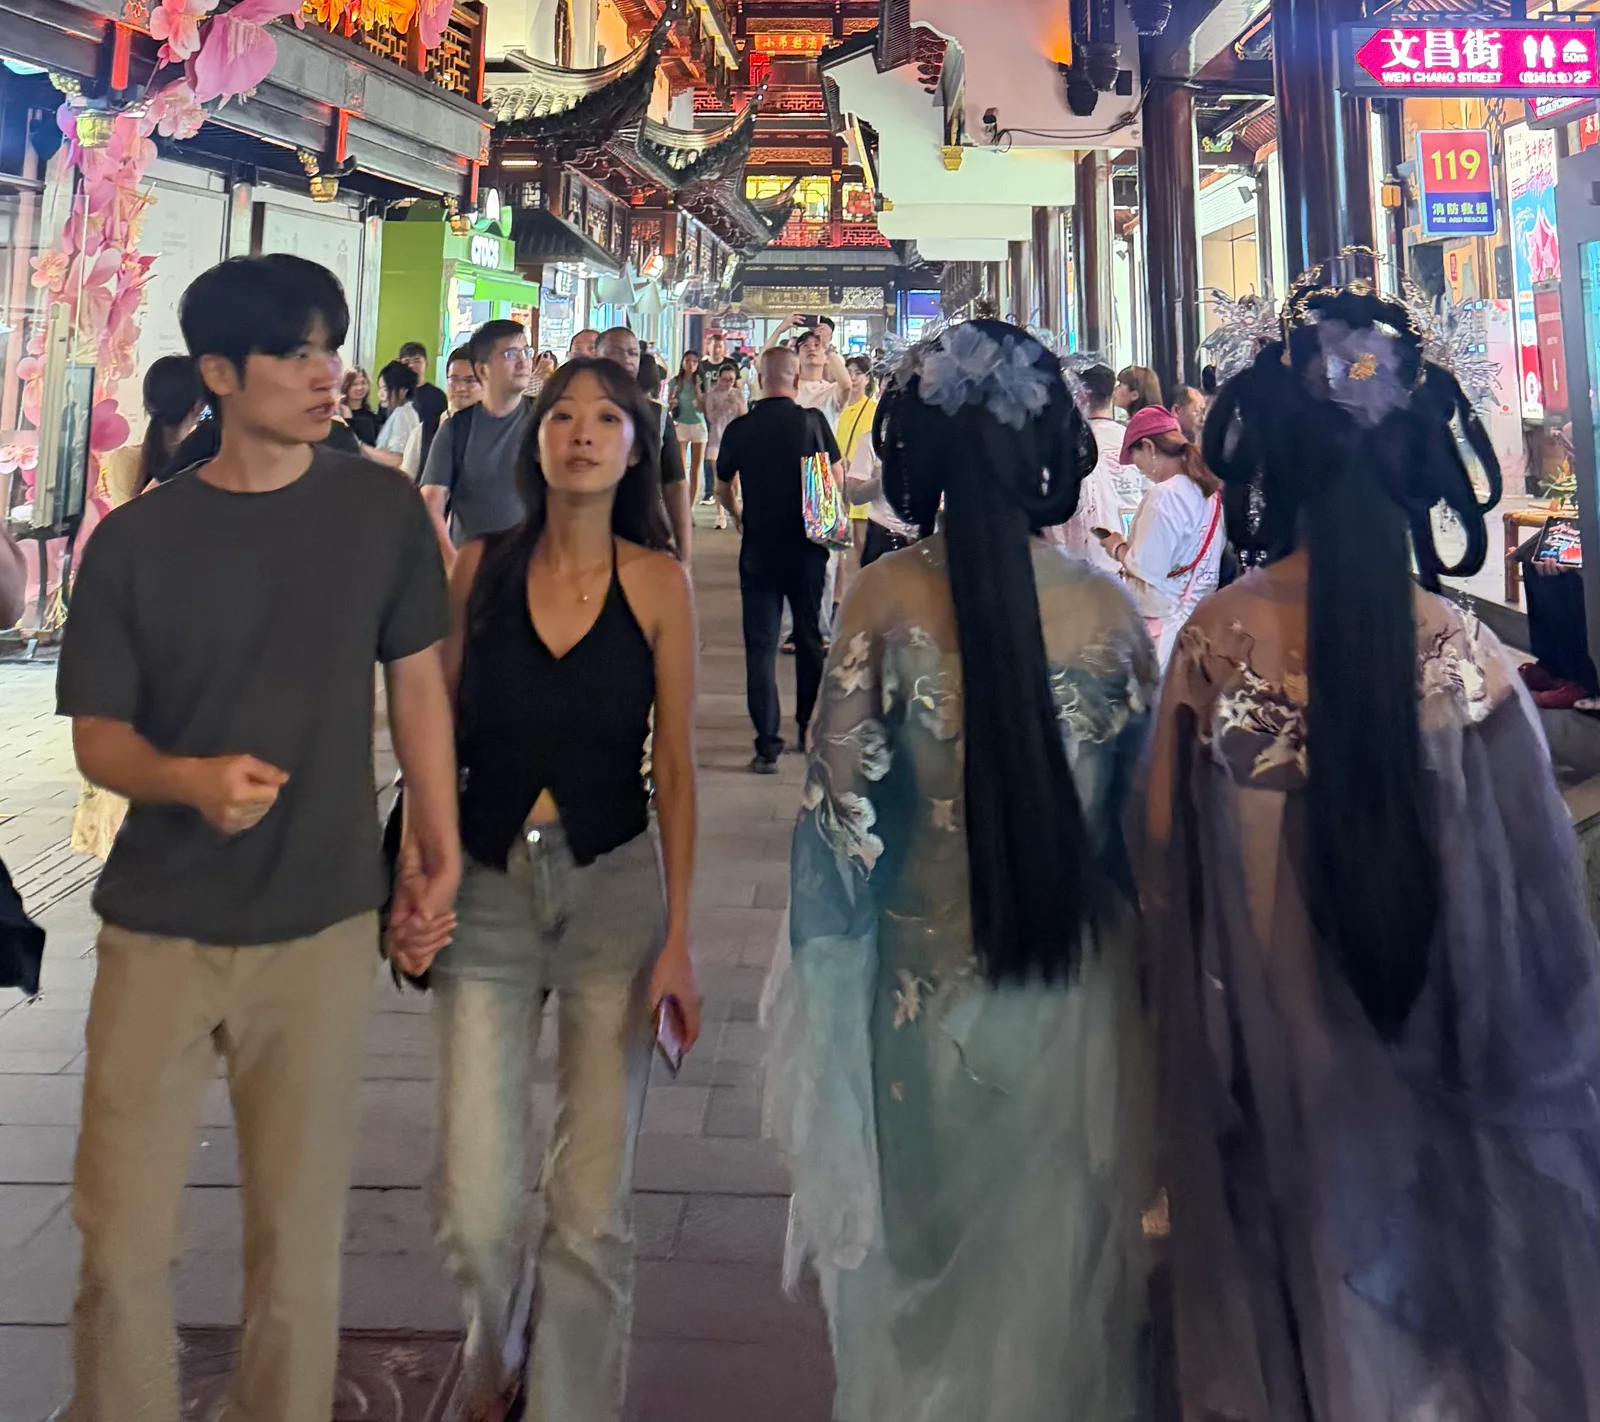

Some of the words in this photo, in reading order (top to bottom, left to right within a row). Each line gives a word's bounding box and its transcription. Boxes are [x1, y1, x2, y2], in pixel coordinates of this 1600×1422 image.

[1381, 29, 1503, 69] 文昌街
[1382, 72, 1411, 83] WEN
[1413, 72, 1455, 83] CHANG
[1457, 72, 1502, 83] STREET
[1431, 149, 1480, 180] 119
[1432, 202, 1488, 215] 消防救援
[1464, 216, 1488, 224] RESCUE
[472, 235, 499, 269] crocs
